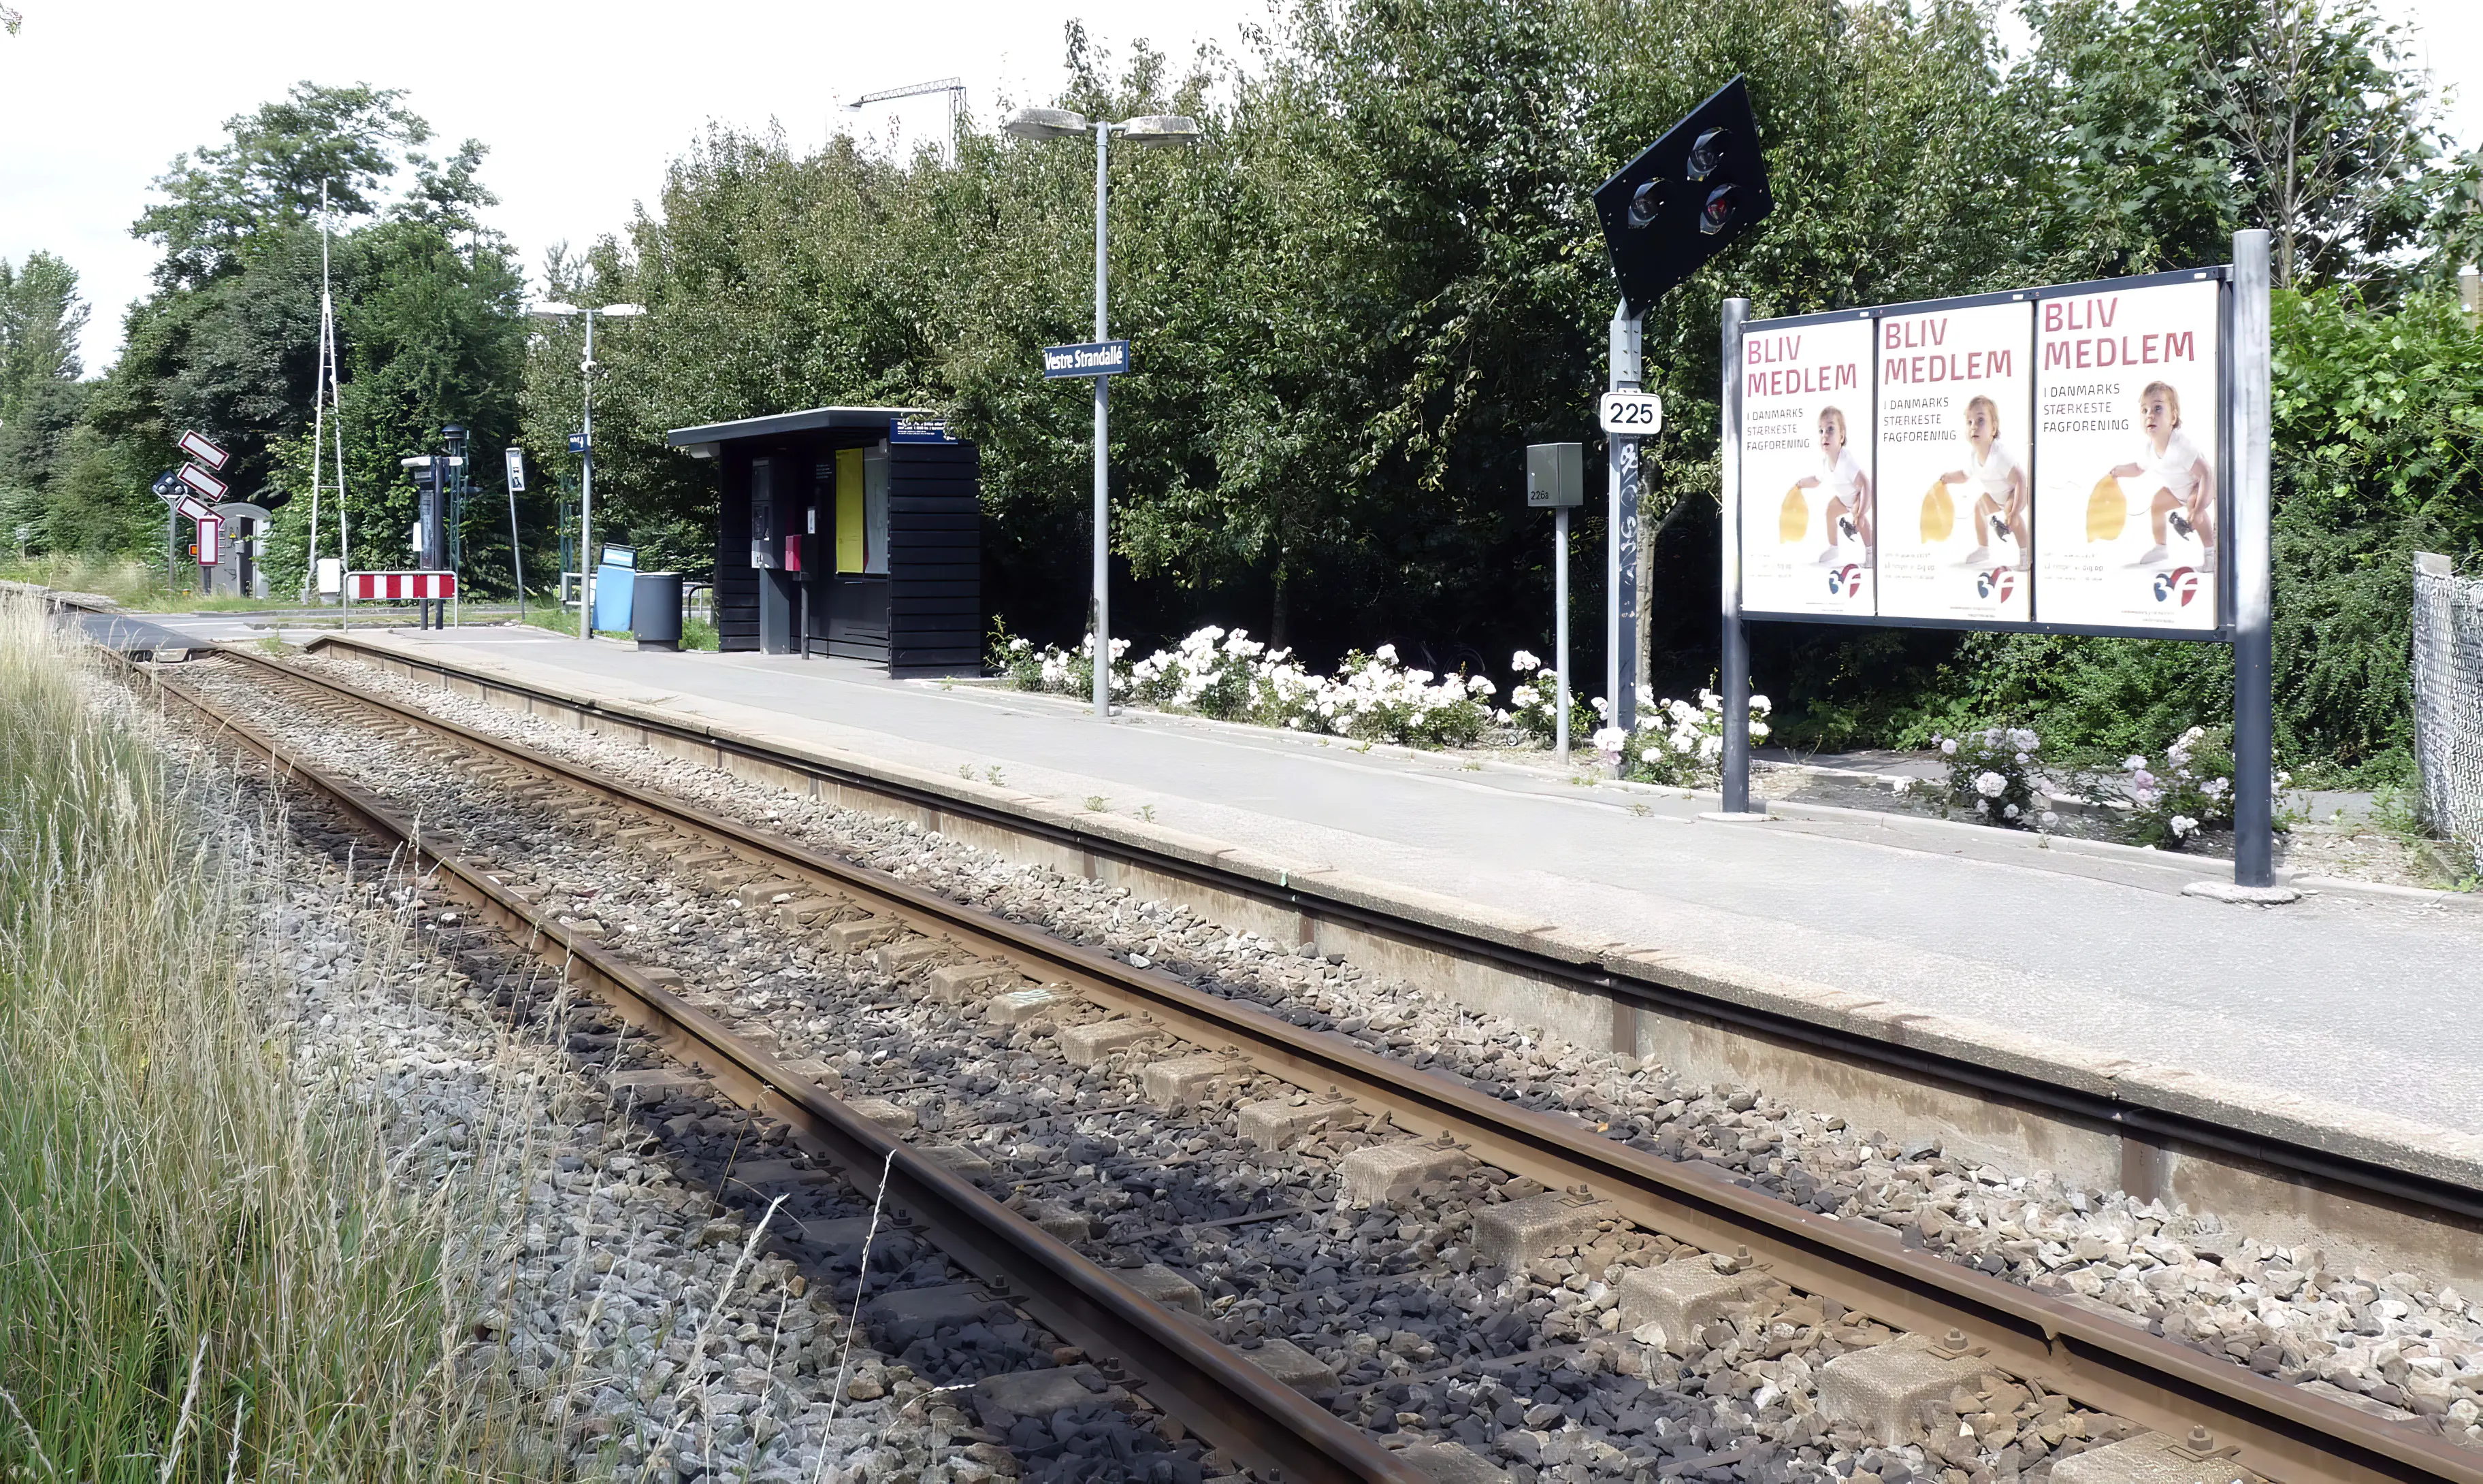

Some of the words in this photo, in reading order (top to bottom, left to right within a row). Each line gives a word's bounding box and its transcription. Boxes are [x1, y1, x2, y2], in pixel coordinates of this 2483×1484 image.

[2045, 297, 2117, 332] BLIV
[1885, 318, 1947, 350] BLIV
[1748, 335, 1801, 365] BLIV
[2045, 331, 2194, 370] MEDLEM
[1045, 352, 1073, 370] Vestre
[1075, 346, 1123, 367] Strandallé
[1885, 350, 2011, 385] MEDLEM
[1748, 363, 1857, 397] MEDLEM
[2051, 384, 2120, 397] DANMARKS
[1890, 397, 1949, 410] DANMARKS
[2044, 402, 2111, 415] STÆRKESTE
[1610, 403, 1653, 424] 225
[1753, 408, 1803, 420] DANMARKS
[1884, 414, 1941, 426] STÆRKESTE
[1747, 424, 1798, 435] STÆRKESTE
[2044, 419, 2129, 432] FAGFORENING
[1884, 430, 1956, 442] FAGFORENING
[1747, 439, 1810, 450] FAGFORENING
[1531, 491, 1549, 500] 226a
